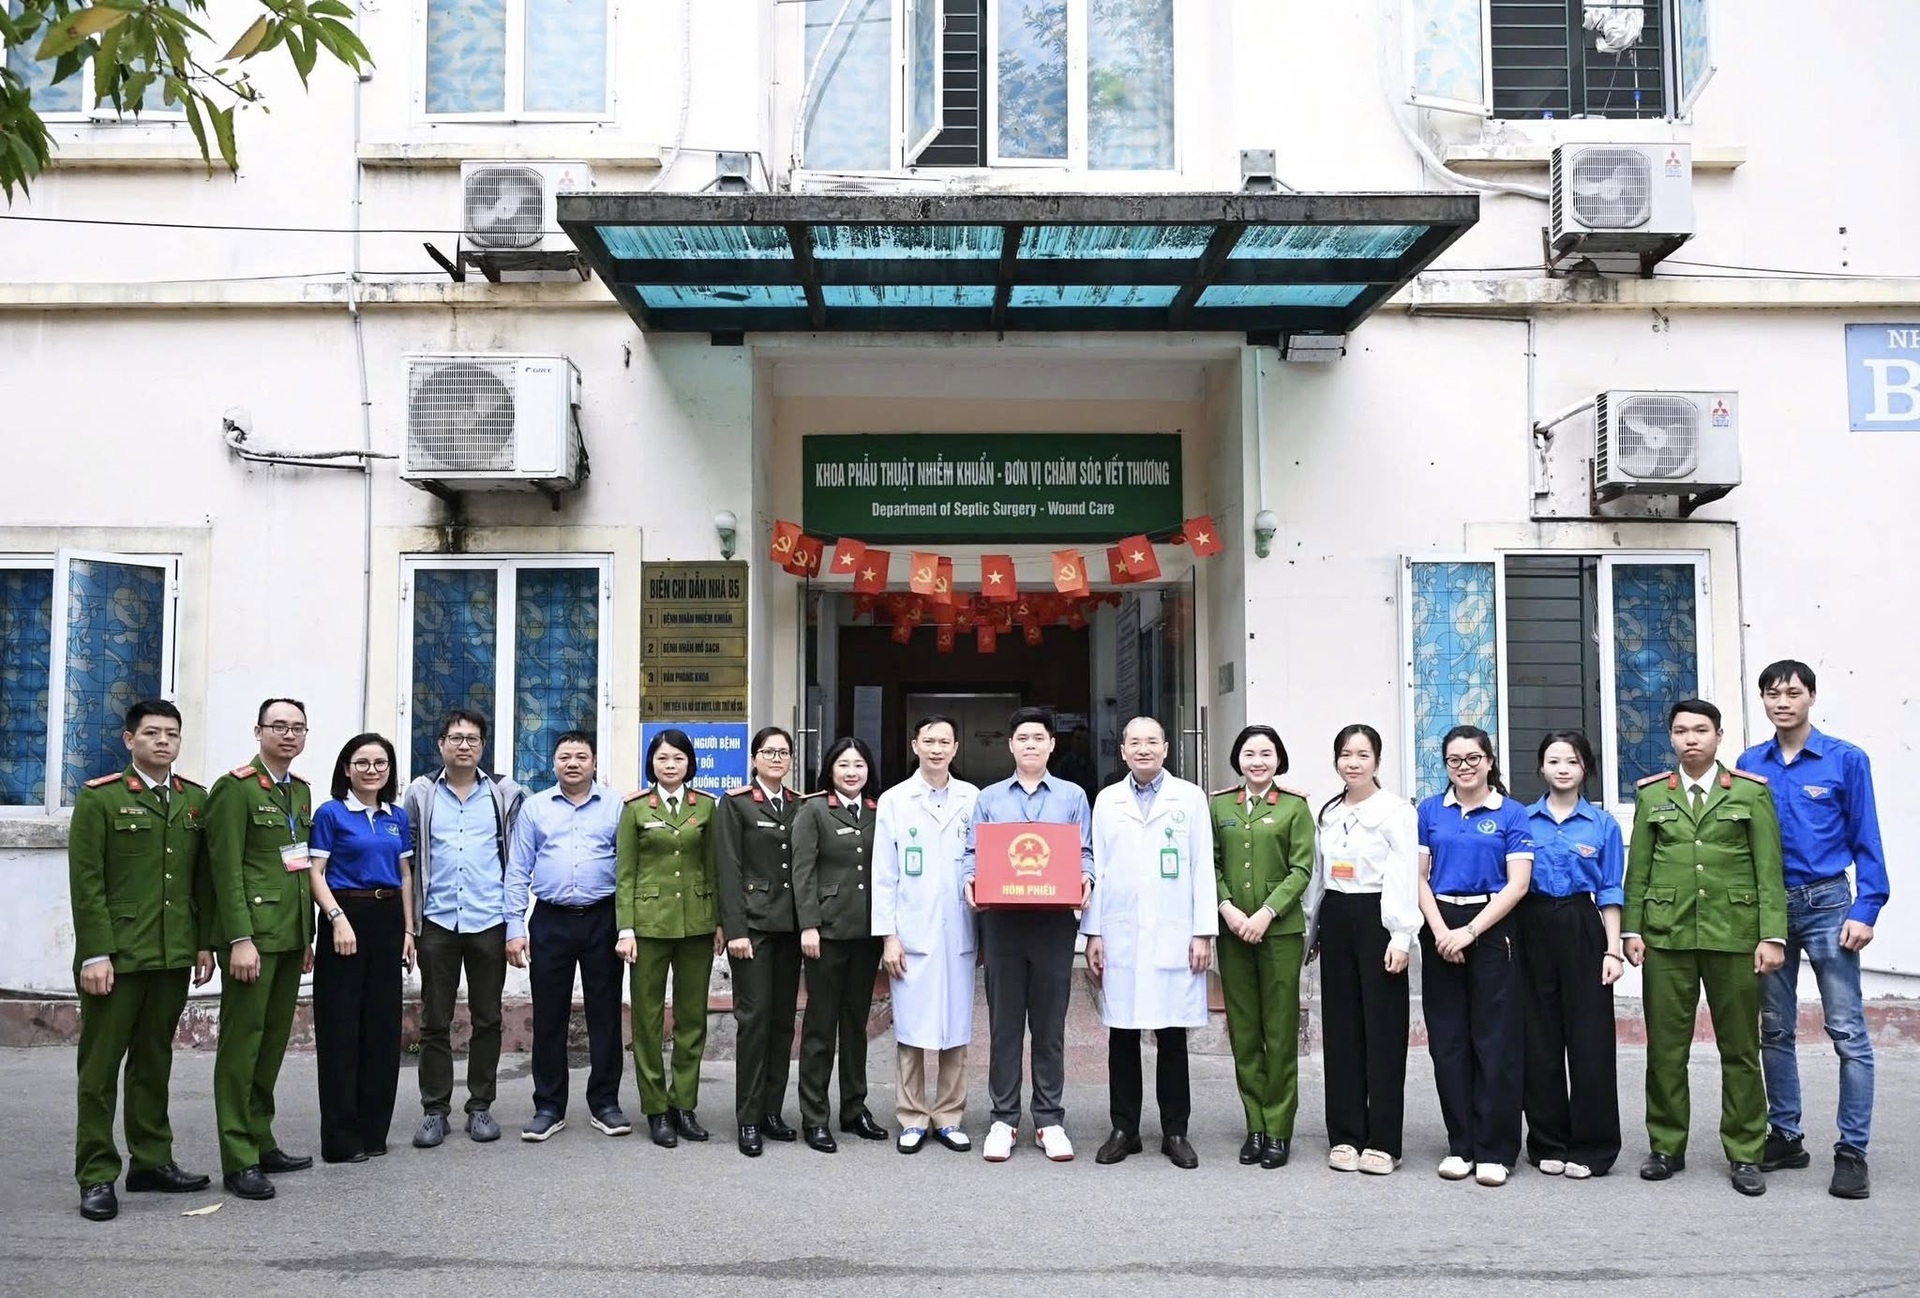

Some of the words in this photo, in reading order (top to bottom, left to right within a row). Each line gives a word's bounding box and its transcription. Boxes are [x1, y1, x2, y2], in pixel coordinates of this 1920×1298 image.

[816, 463, 845, 487] KHOA
[848, 453, 877, 487] PHẪU
[881, 457, 914, 491] THUẬT
[918, 453, 953, 486] NHIỄM
[957, 452, 993, 486] KHUẨN
[1005, 459, 1027, 485] ĐƠN
[1031, 461, 1041, 491] VỊ
[1045, 457, 1076, 485] CHĂM
[1080, 456, 1101, 485] SÓC
[1105, 453, 1123, 485] VẾT
[1126, 459, 1169, 486] THƯƠNG
[872, 502, 936, 517] Department
[940, 502, 951, 516] of
[954, 502, 989, 517] Septic
[993, 502, 1036, 517] Surgery
[1048, 501, 1085, 515] Wound
[1089, 502, 1114, 515] Care
[650, 571, 670, 599] BIỂN
[672, 572, 686, 599] CHỈ
[689, 571, 706, 599] DẪN
[709, 575, 726, 599] NHÀ
[729, 578, 739, 599] B5
[649, 614, 653, 624] 1
[648, 643, 654, 653] 2
[648, 672, 653, 682] 3
[648, 702, 653, 711] 4
[694, 736, 718, 749] NGƯỜI
[719, 736, 740, 751] BỆNH
[701, 754, 714, 768] ĐỐI
[721, 775, 742, 789] BỆNH
